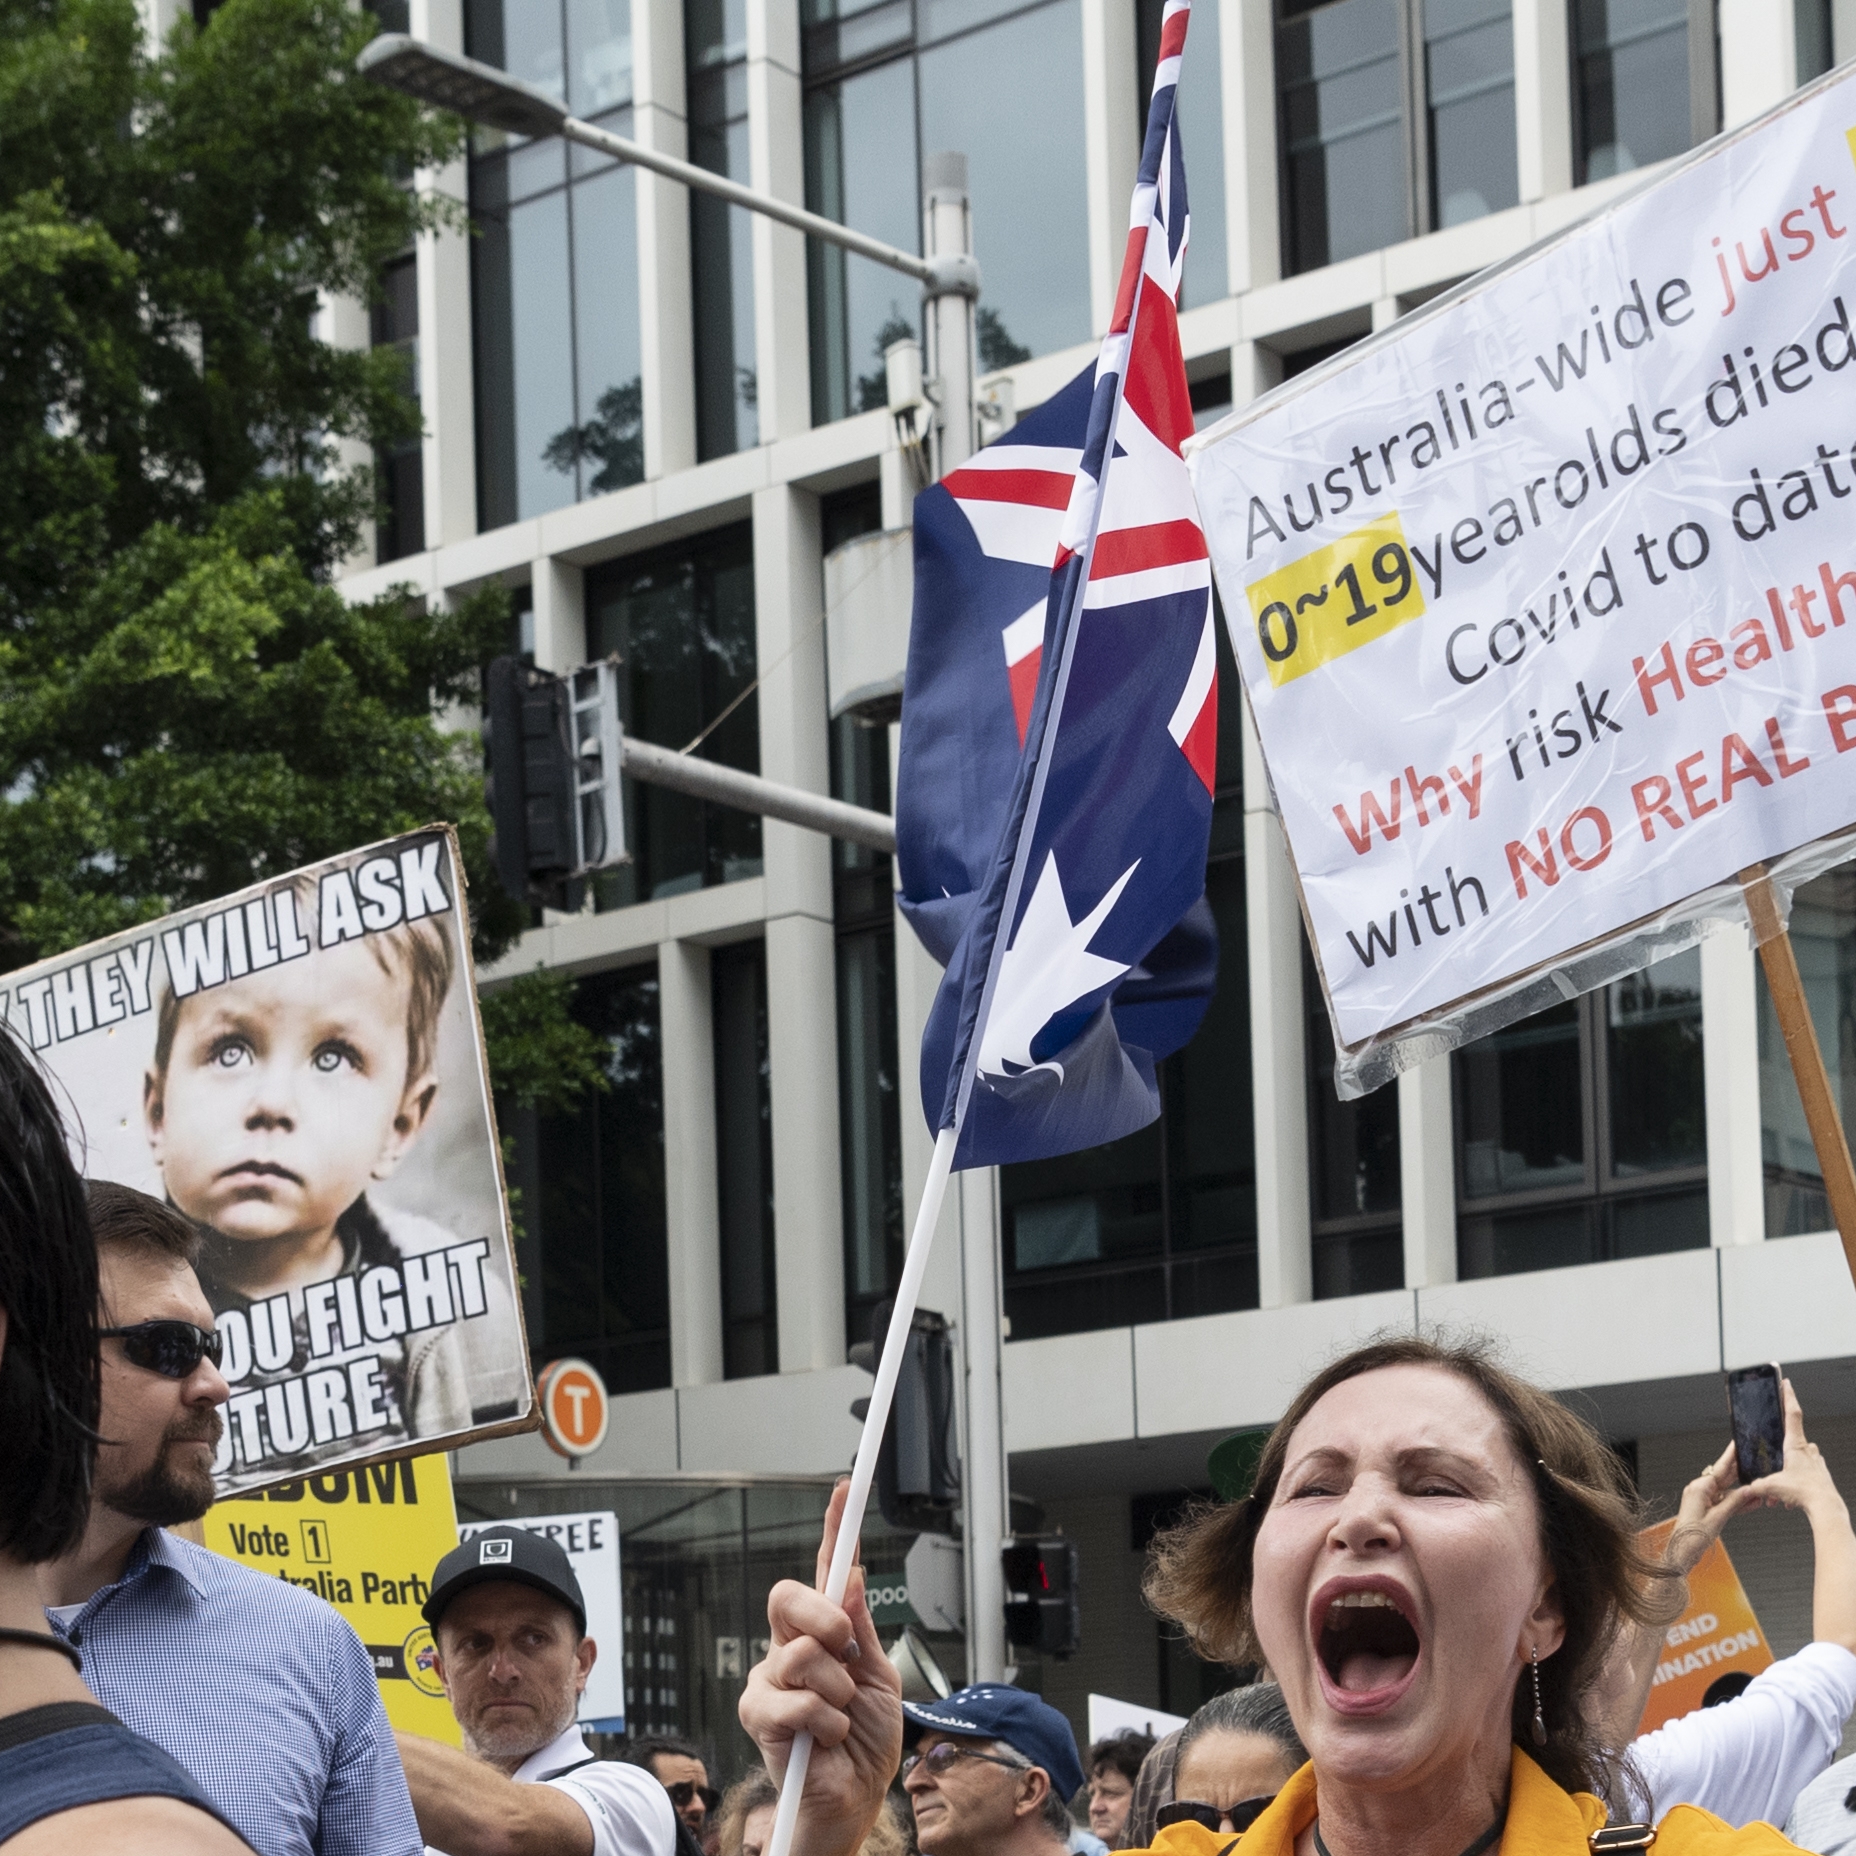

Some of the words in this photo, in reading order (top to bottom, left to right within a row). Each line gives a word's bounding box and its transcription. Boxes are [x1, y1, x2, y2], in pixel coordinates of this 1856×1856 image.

[1245, 277, 1694, 560] Australia-wide
[1711, 186, 1848, 315] just
[1445, 547, 1623, 686] Covid
[1634, 518, 1711, 586] to
[1333, 754, 1486, 858] Why
[1505, 681, 1623, 782] risk
[1343, 866, 1489, 970] with
[1505, 806, 1614, 903] NO
[1630, 730, 1812, 844] REAL
[18, 935, 155, 1051] THEY
[161, 888, 311, 1000] WILL
[317, 841, 452, 950] ASK
[214, 1291, 294, 1384] OU
[302, 1236, 491, 1361] FIGHT
[211, 1353, 389, 1476] TURE
[564, 1384, 591, 1437] T
[228, 1523, 290, 1557] Vote
[307, 1525, 322, 1558] 1
[1652, 1628, 1760, 1687] INATION
